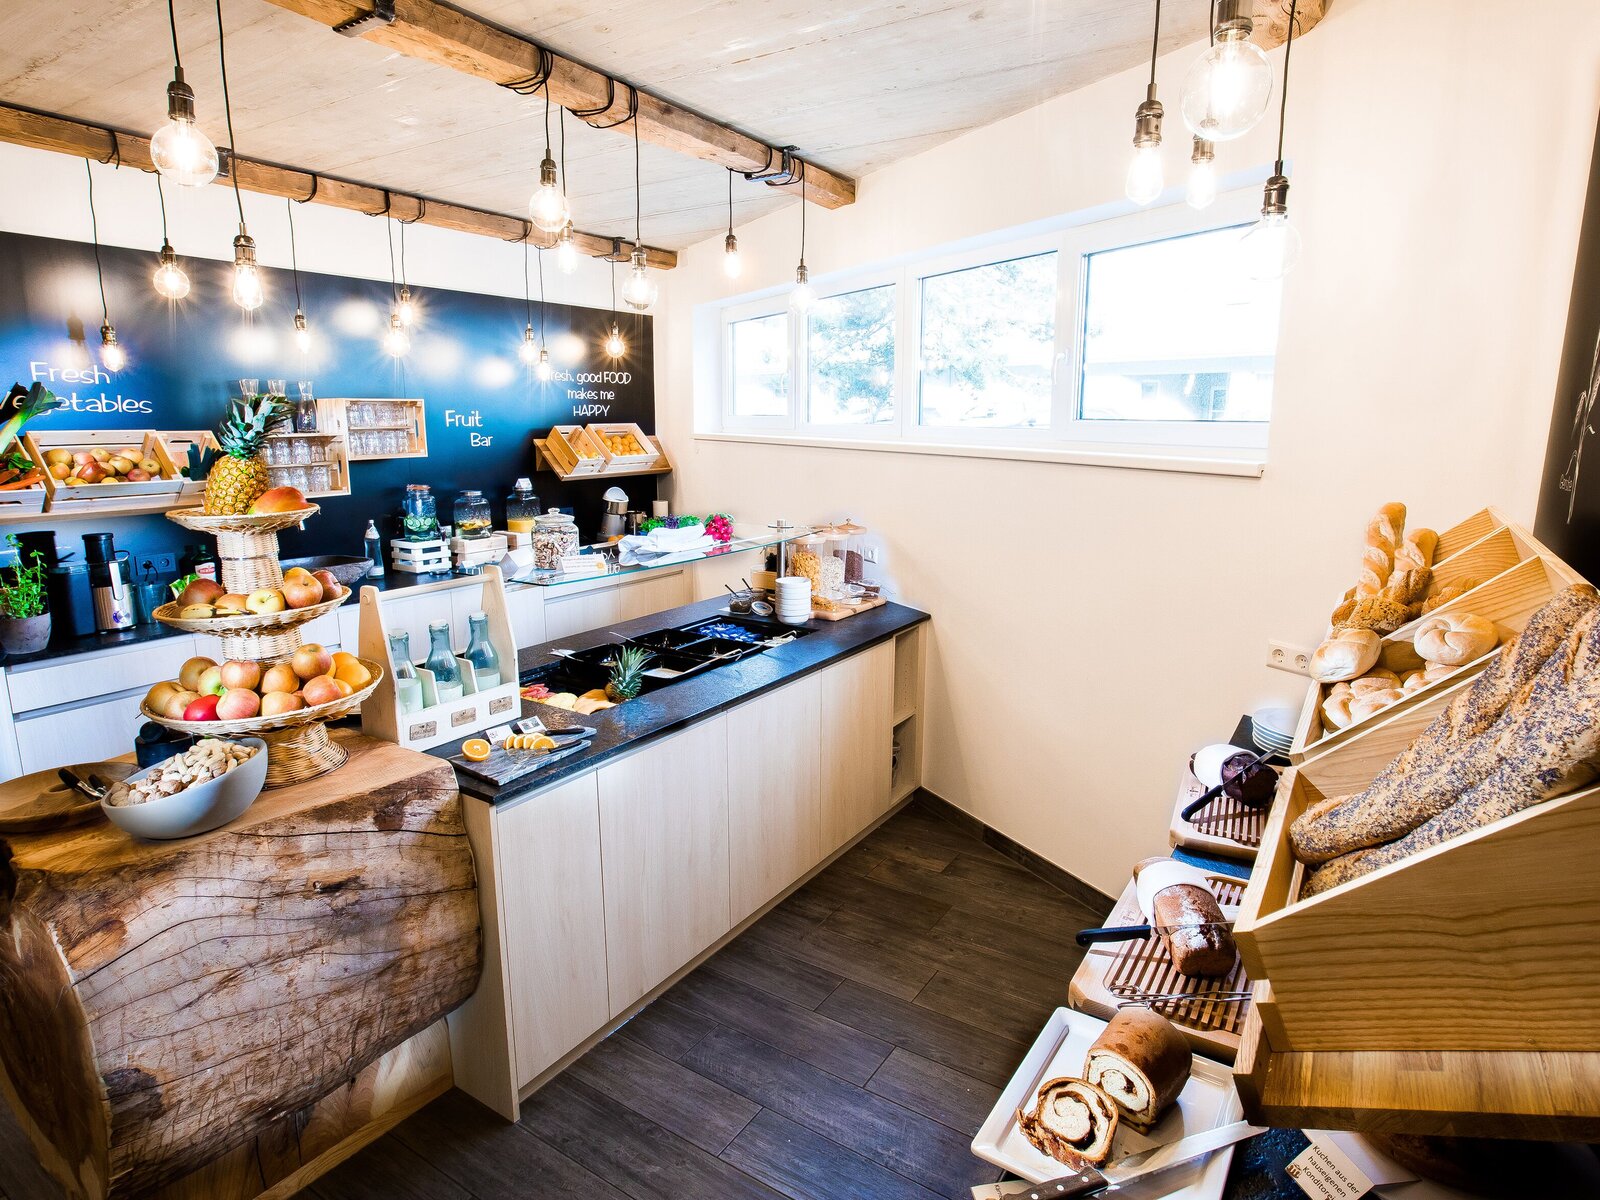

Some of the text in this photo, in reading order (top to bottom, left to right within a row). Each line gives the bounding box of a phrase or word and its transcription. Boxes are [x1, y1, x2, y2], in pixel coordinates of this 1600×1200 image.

[30, 361, 111, 384] Fresh
[576, 371, 602, 385] good
[603, 371, 632, 385] FOOD
[567, 388, 615, 400] makes me
[445, 410, 483, 427] Fruit
[573, 404, 610, 417] HAPPY
[470, 432, 493, 447] Bar
[1307, 1155, 1347, 1198] hauseigenen
[1312, 1145, 1360, 1194] Kuchen aus der
